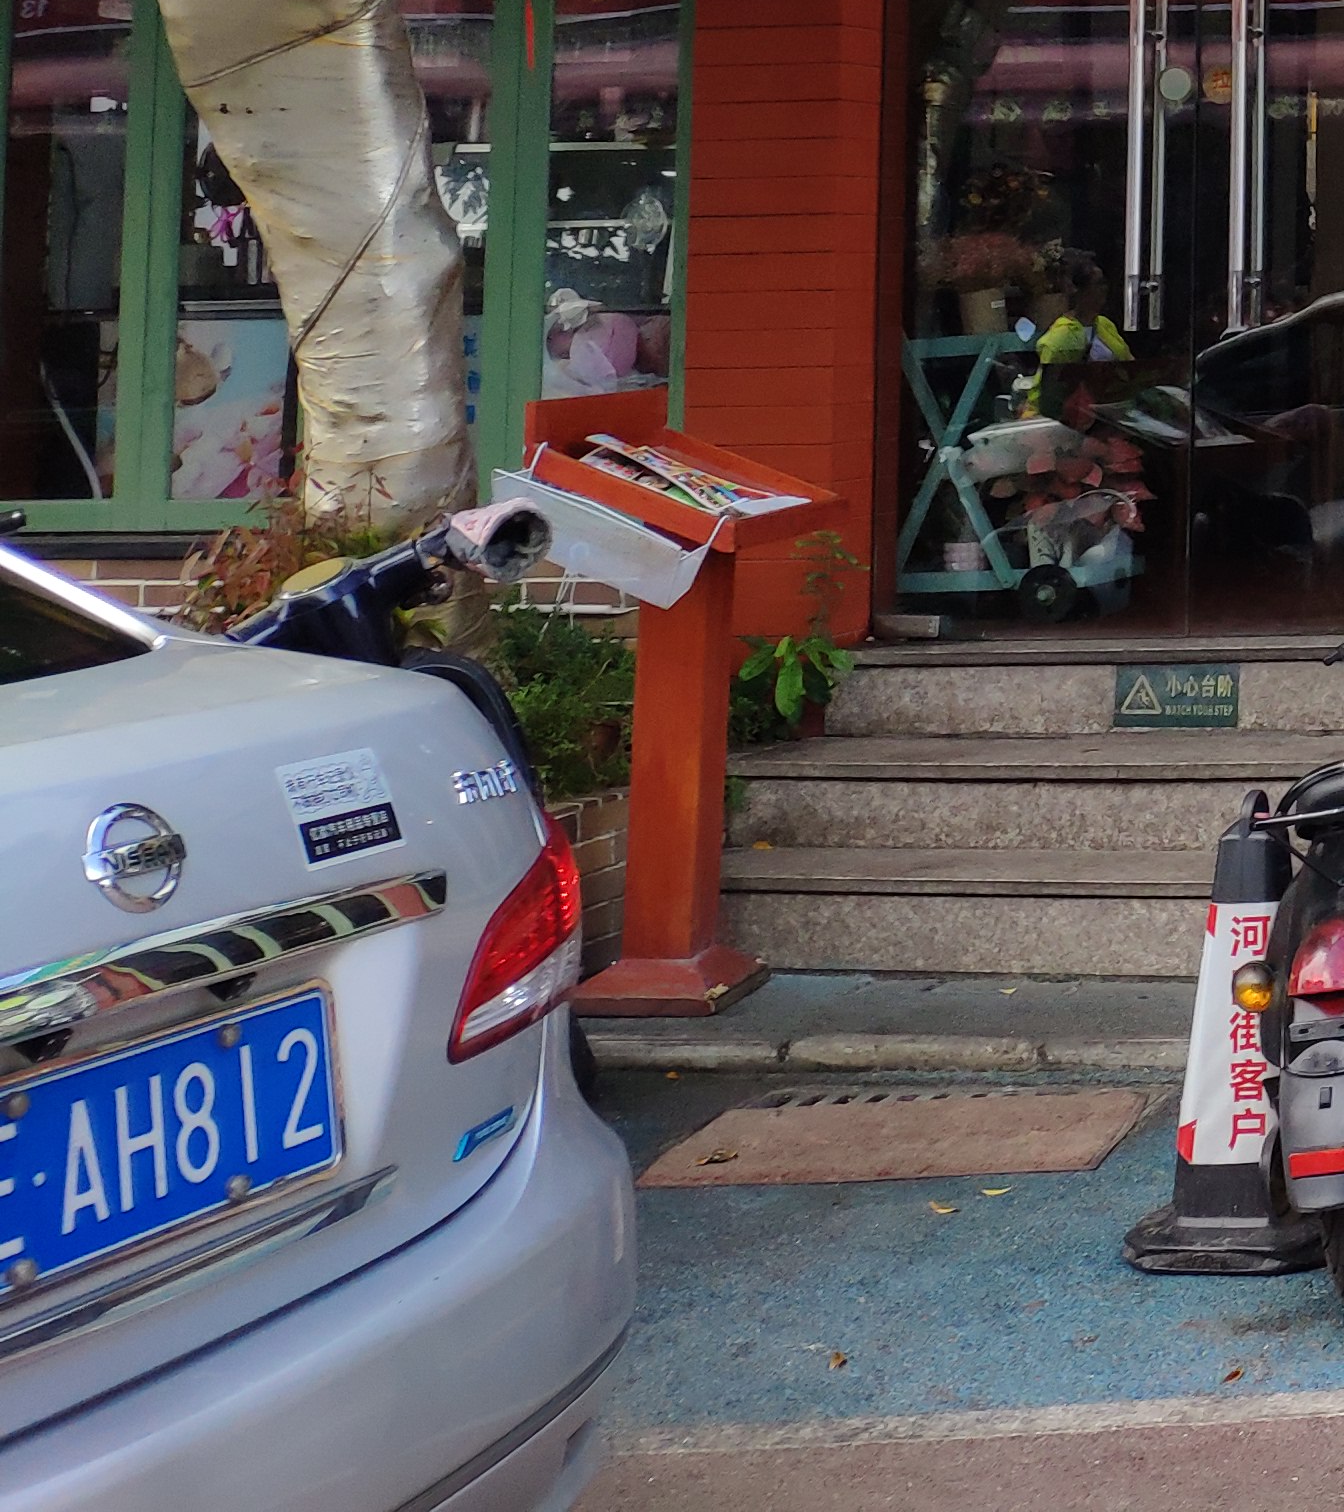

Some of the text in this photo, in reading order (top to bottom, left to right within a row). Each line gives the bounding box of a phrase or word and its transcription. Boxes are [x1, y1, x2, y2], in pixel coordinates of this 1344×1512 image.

[1165, 674, 1233, 697] 小心台阶
[1214, 704, 1233, 715] STEP
[1229, 916, 1271, 1150] 河街客户
